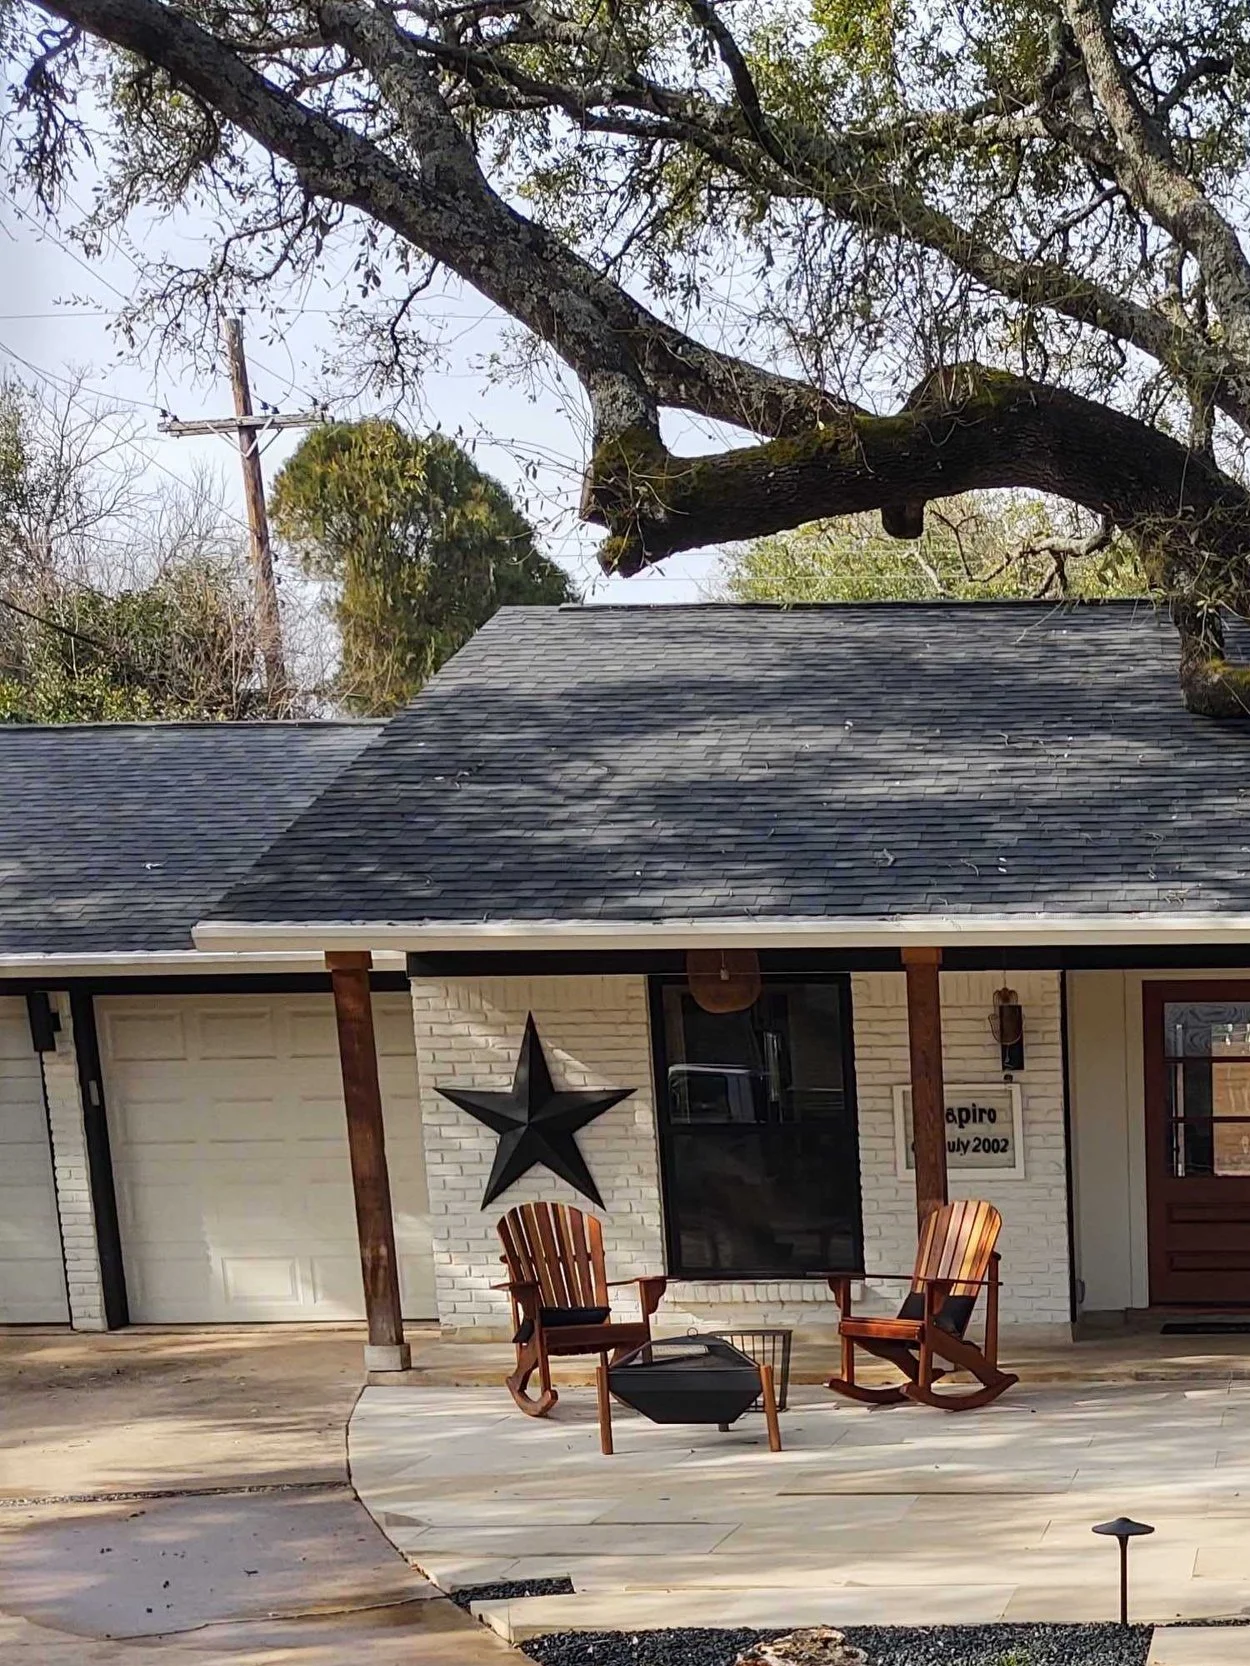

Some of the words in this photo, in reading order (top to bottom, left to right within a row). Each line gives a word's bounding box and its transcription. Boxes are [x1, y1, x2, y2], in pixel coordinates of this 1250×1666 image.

[945, 1103, 997, 1129] apiro
[947, 1137, 970, 1156] uly
[972, 1137, 1009, 1153] 2002
